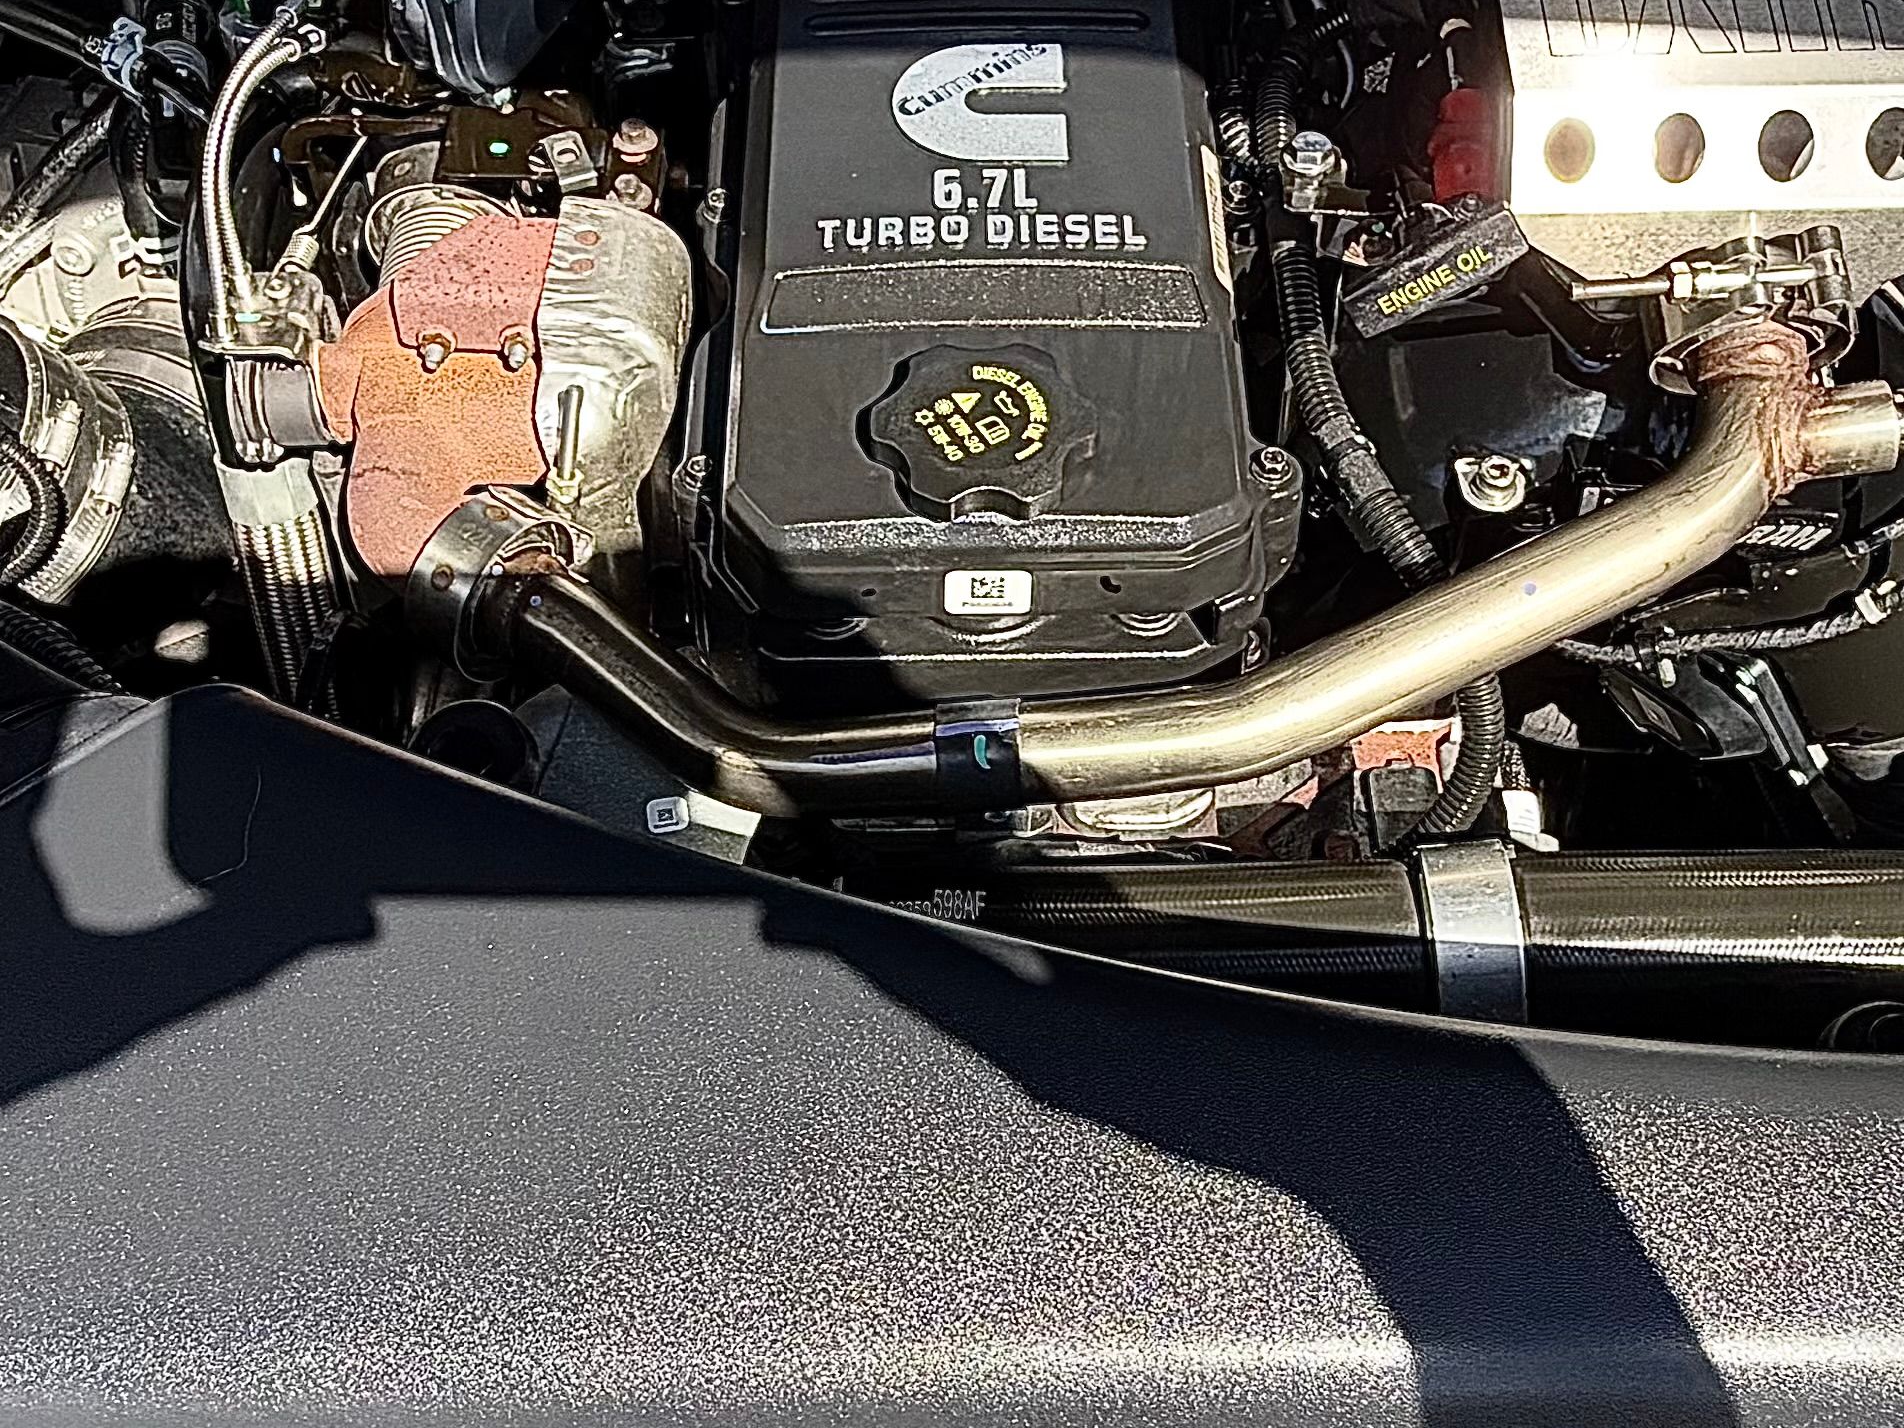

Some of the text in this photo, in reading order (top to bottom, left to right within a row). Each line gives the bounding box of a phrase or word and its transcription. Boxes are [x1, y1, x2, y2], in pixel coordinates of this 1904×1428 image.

[897, 43, 1048, 116] Cummins
[932, 167, 1039, 211] 6.7L
[817, 214, 1148, 250] TURBO DIESEL
[1377, 245, 1494, 316] ENGINE OIL
[972, 365, 1048, 440] DIESEL ENGINE OIL
[927, 424, 964, 461] 5W-40
[947, 414, 985, 453] 10W-30
